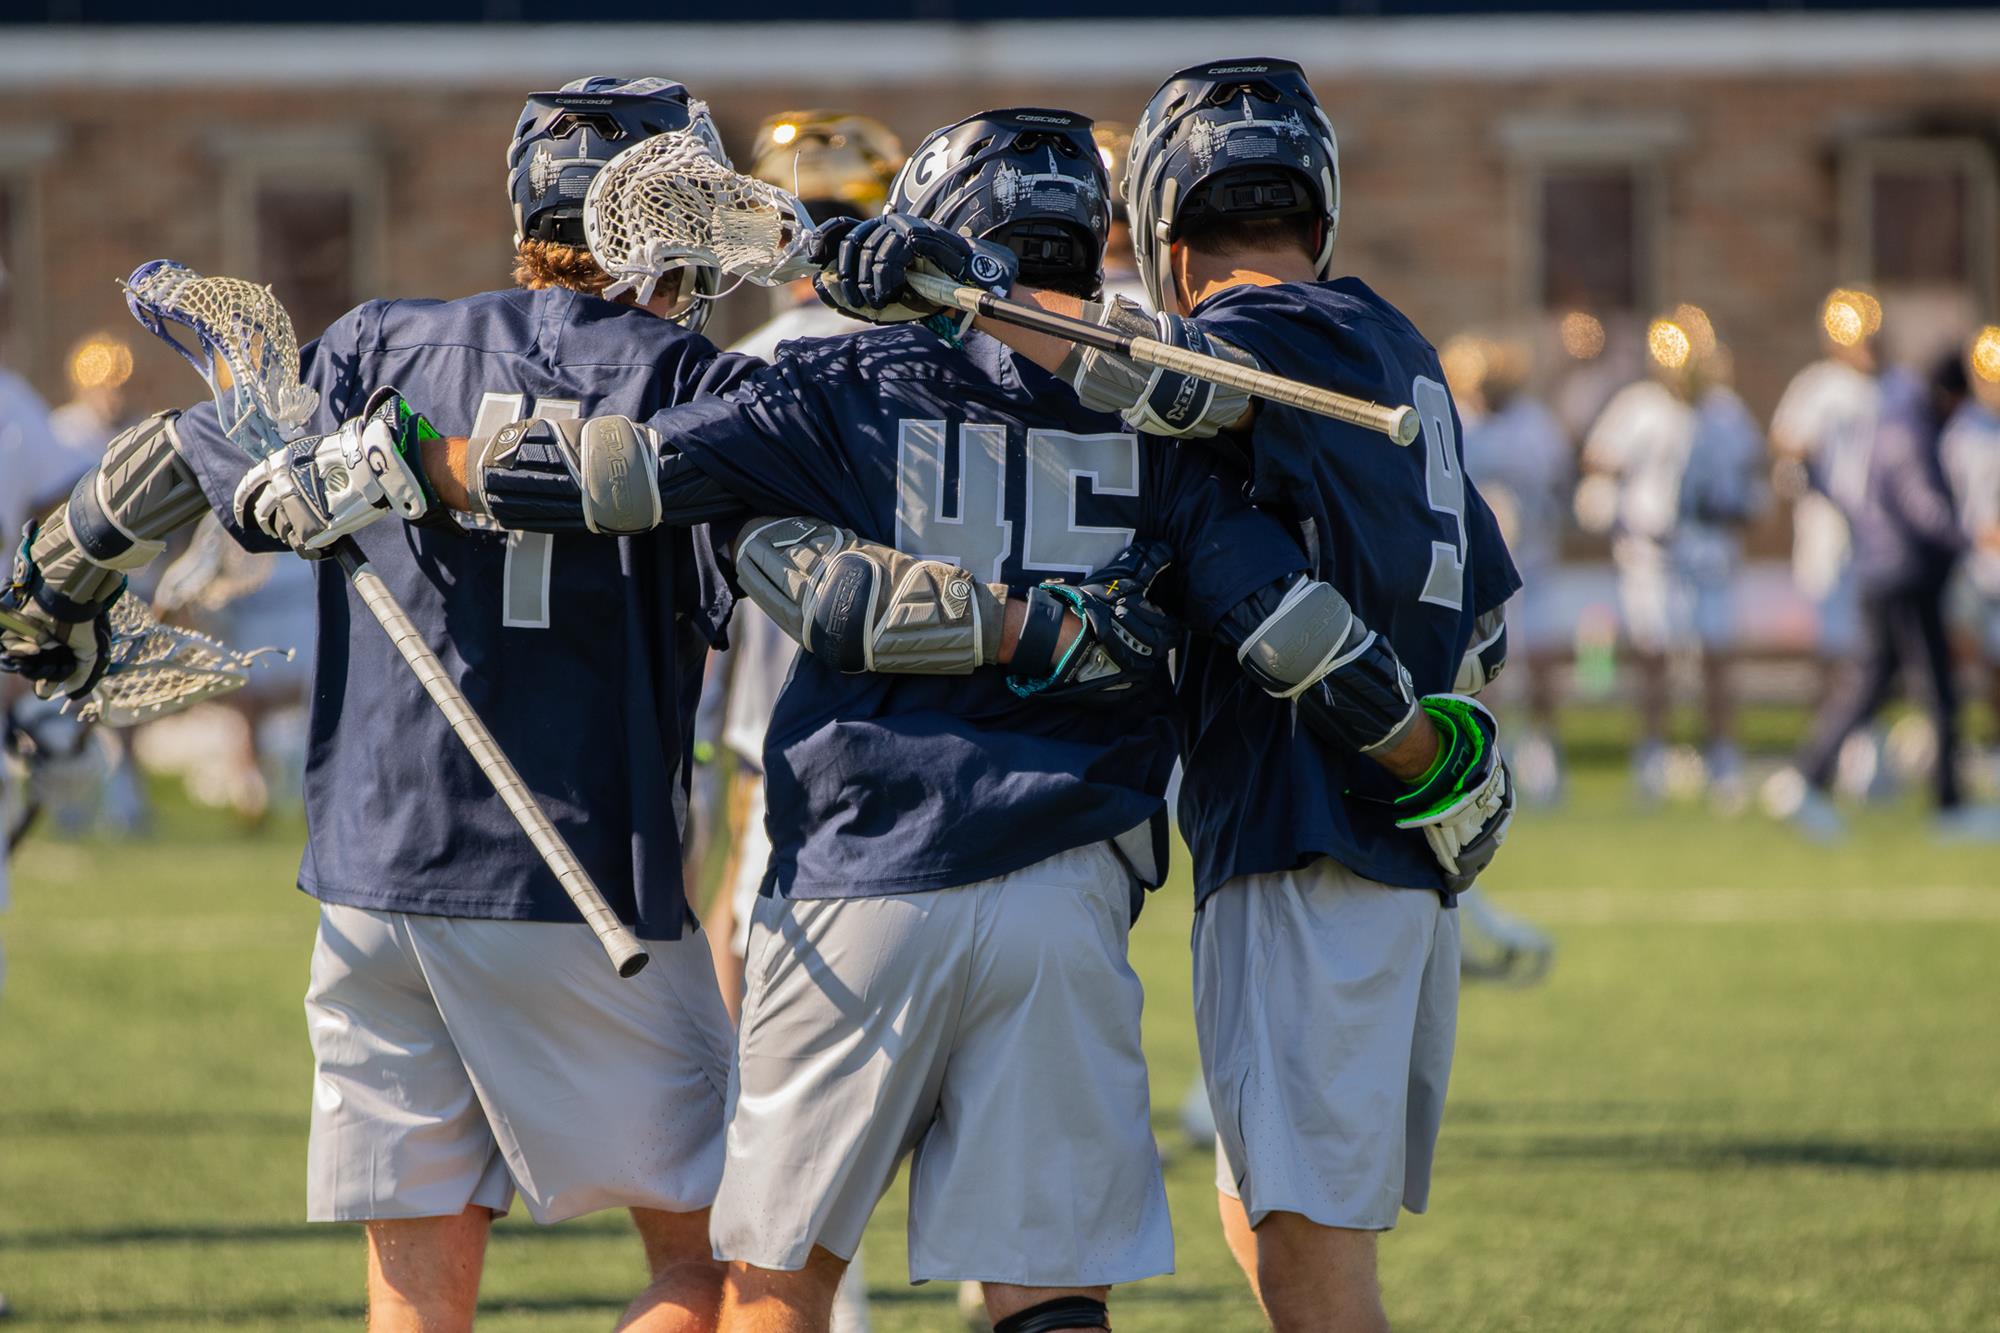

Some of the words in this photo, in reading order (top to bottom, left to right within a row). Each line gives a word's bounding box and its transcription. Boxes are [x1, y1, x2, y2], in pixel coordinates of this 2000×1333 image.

[1207, 65, 1269, 75] cascade
[555, 97, 613, 105] cascade
[1016, 113, 1072, 125] cascade
[1302, 155, 1311, 168] 9
[1090, 215, 1101, 229] 45
[1412, 374, 1468, 611] 9
[895, 418, 1139, 585] 45
